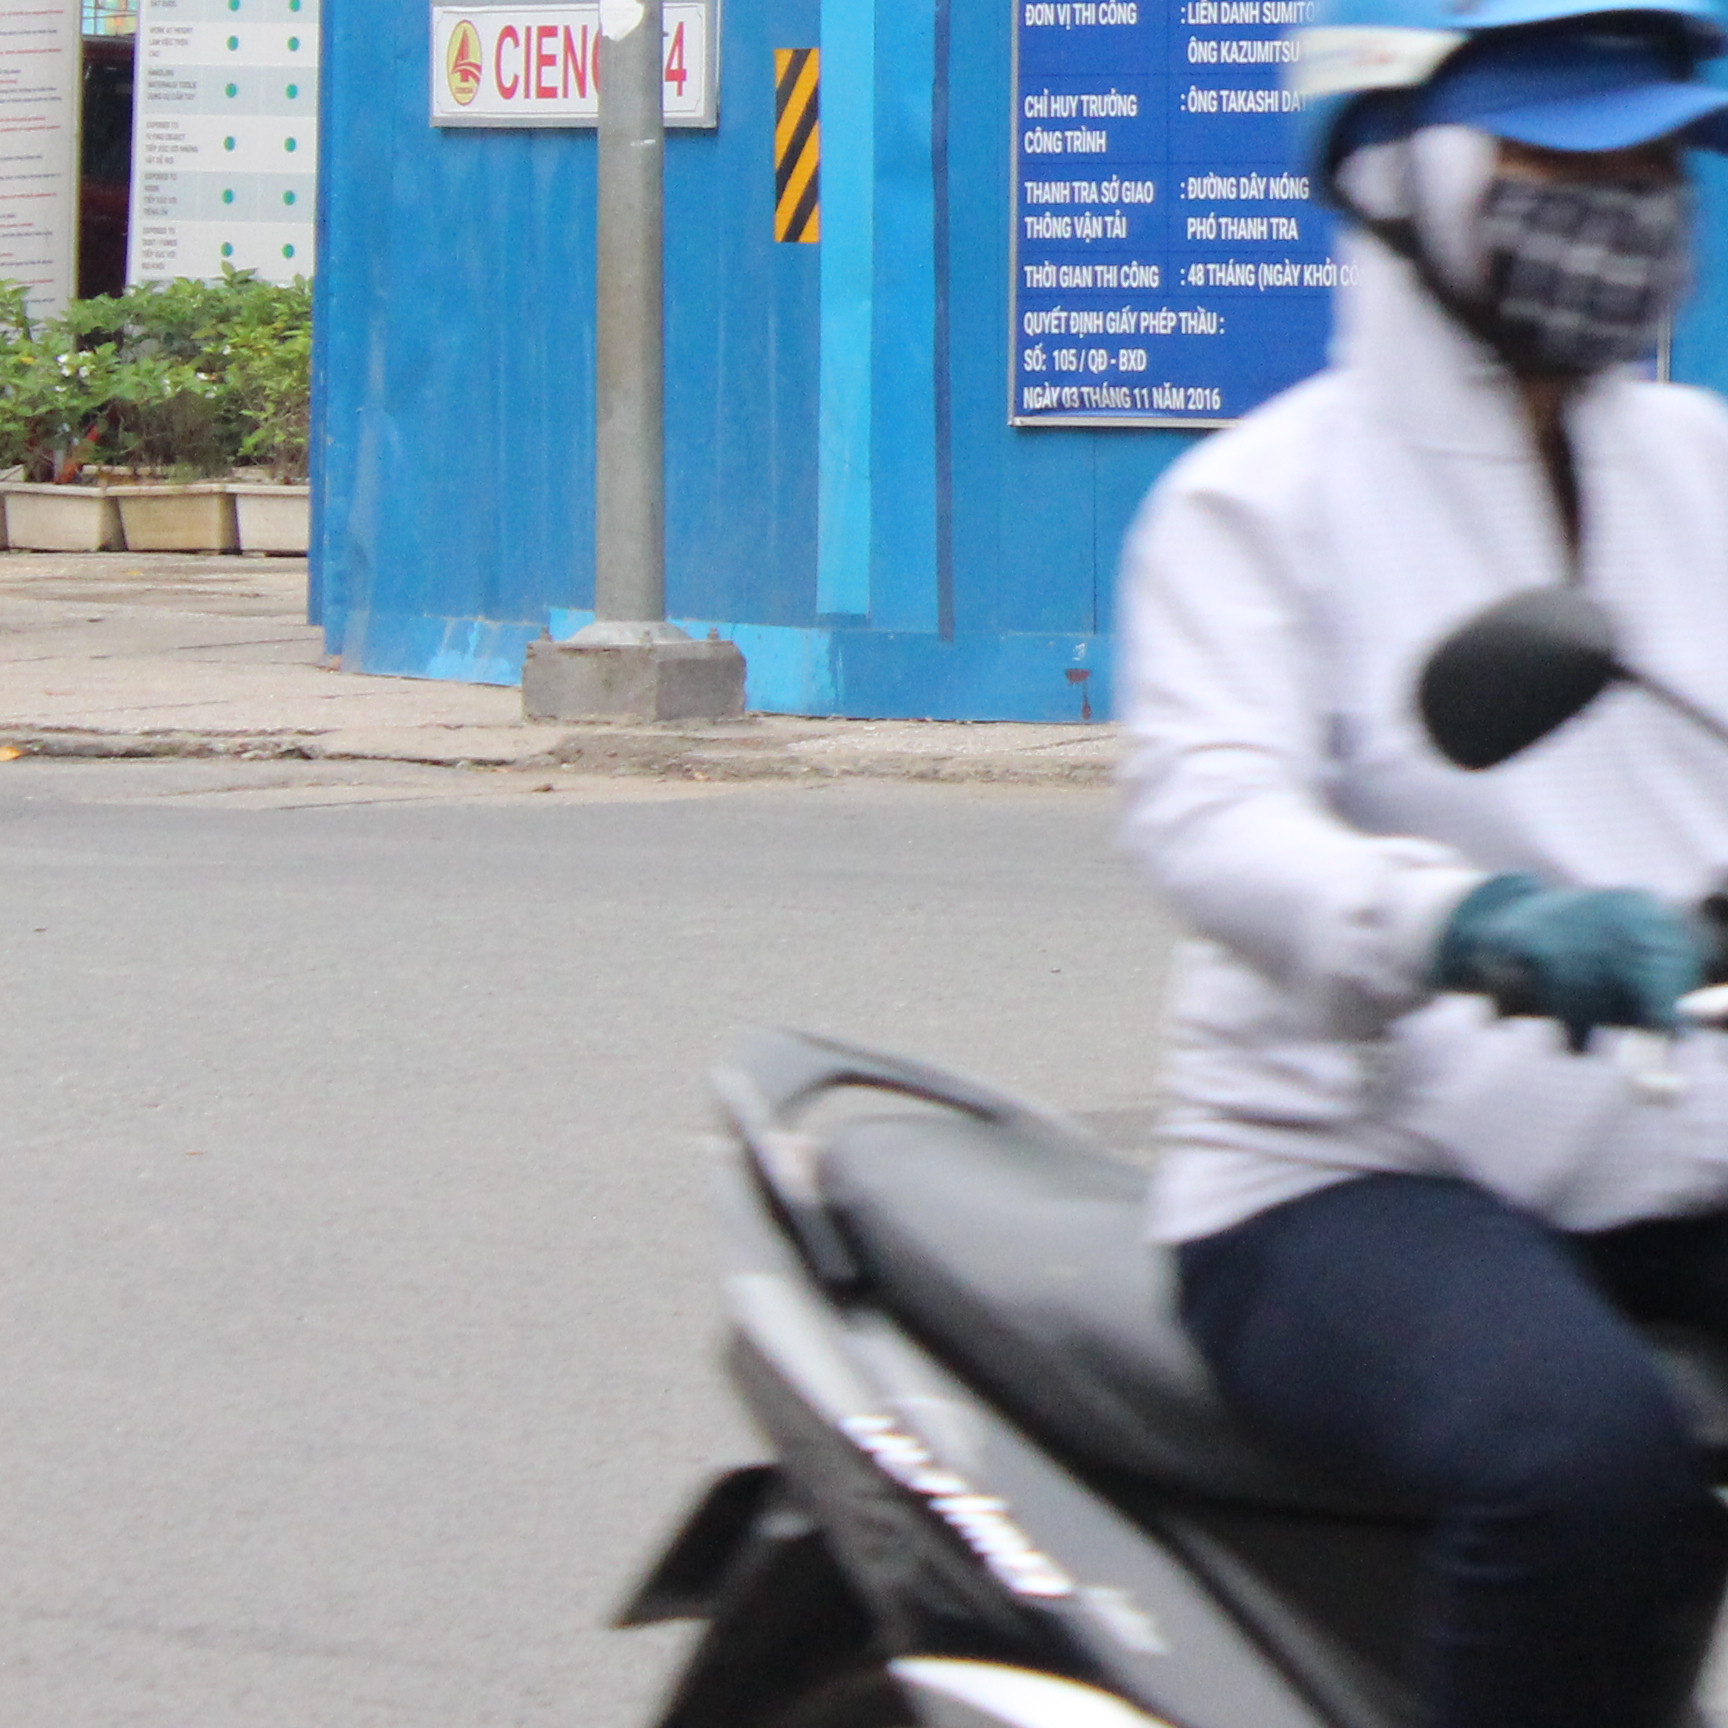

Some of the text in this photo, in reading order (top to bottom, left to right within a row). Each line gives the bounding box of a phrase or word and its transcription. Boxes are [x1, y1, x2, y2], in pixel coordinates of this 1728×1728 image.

[1025, 3, 1054, 26] ĐƠN
[1057, 3, 1071, 31] VỊ
[1073, 3, 1096, 25] THI
[1221, 1, 1259, 24] DANH
[1263, 1, 1317, 23] SUMITO
[494, 21, 687, 100] CIEN 4
[1187, 36, 1300, 64] ÔNG KAZUMITSU
[1024, 88, 1137, 118] CHỈ HUY TRƯỞNG
[1187, 85, 1218, 113] ÔNG
[1219, 90, 1278, 113] TAKASHI
[1024, 126, 1106, 153] CÔNG TRÌNH
[1024, 174, 1154, 204] THANH TRA SỞ GIAO
[1187, 172, 1310, 200] ĐƯỜNG DÂY NÓNG
[1024, 209, 1126, 243] THÔNG VẬN TẢI
[1187, 212, 1298, 240] PHÓ THANH TRA
[1024, 260, 1159, 288] THỜI GIAN THI CÔNG
[1187, 263, 1205, 286] 48
[1207, 258, 1255, 286] THÁNG
[1258, 258, 1301, 292] (NGÀY
[1303, 257, 1337, 286] KHỞI
[1024, 305, 1217, 338] QUYẾT ĐỊNH GIẤY PHÉP THẦU
[1024, 343, 1147, 373] SỐ: 105 QĐ BXD
[1023, 382, 1221, 409] NGÀY 03 THÁNG 11 NĂM 2016
